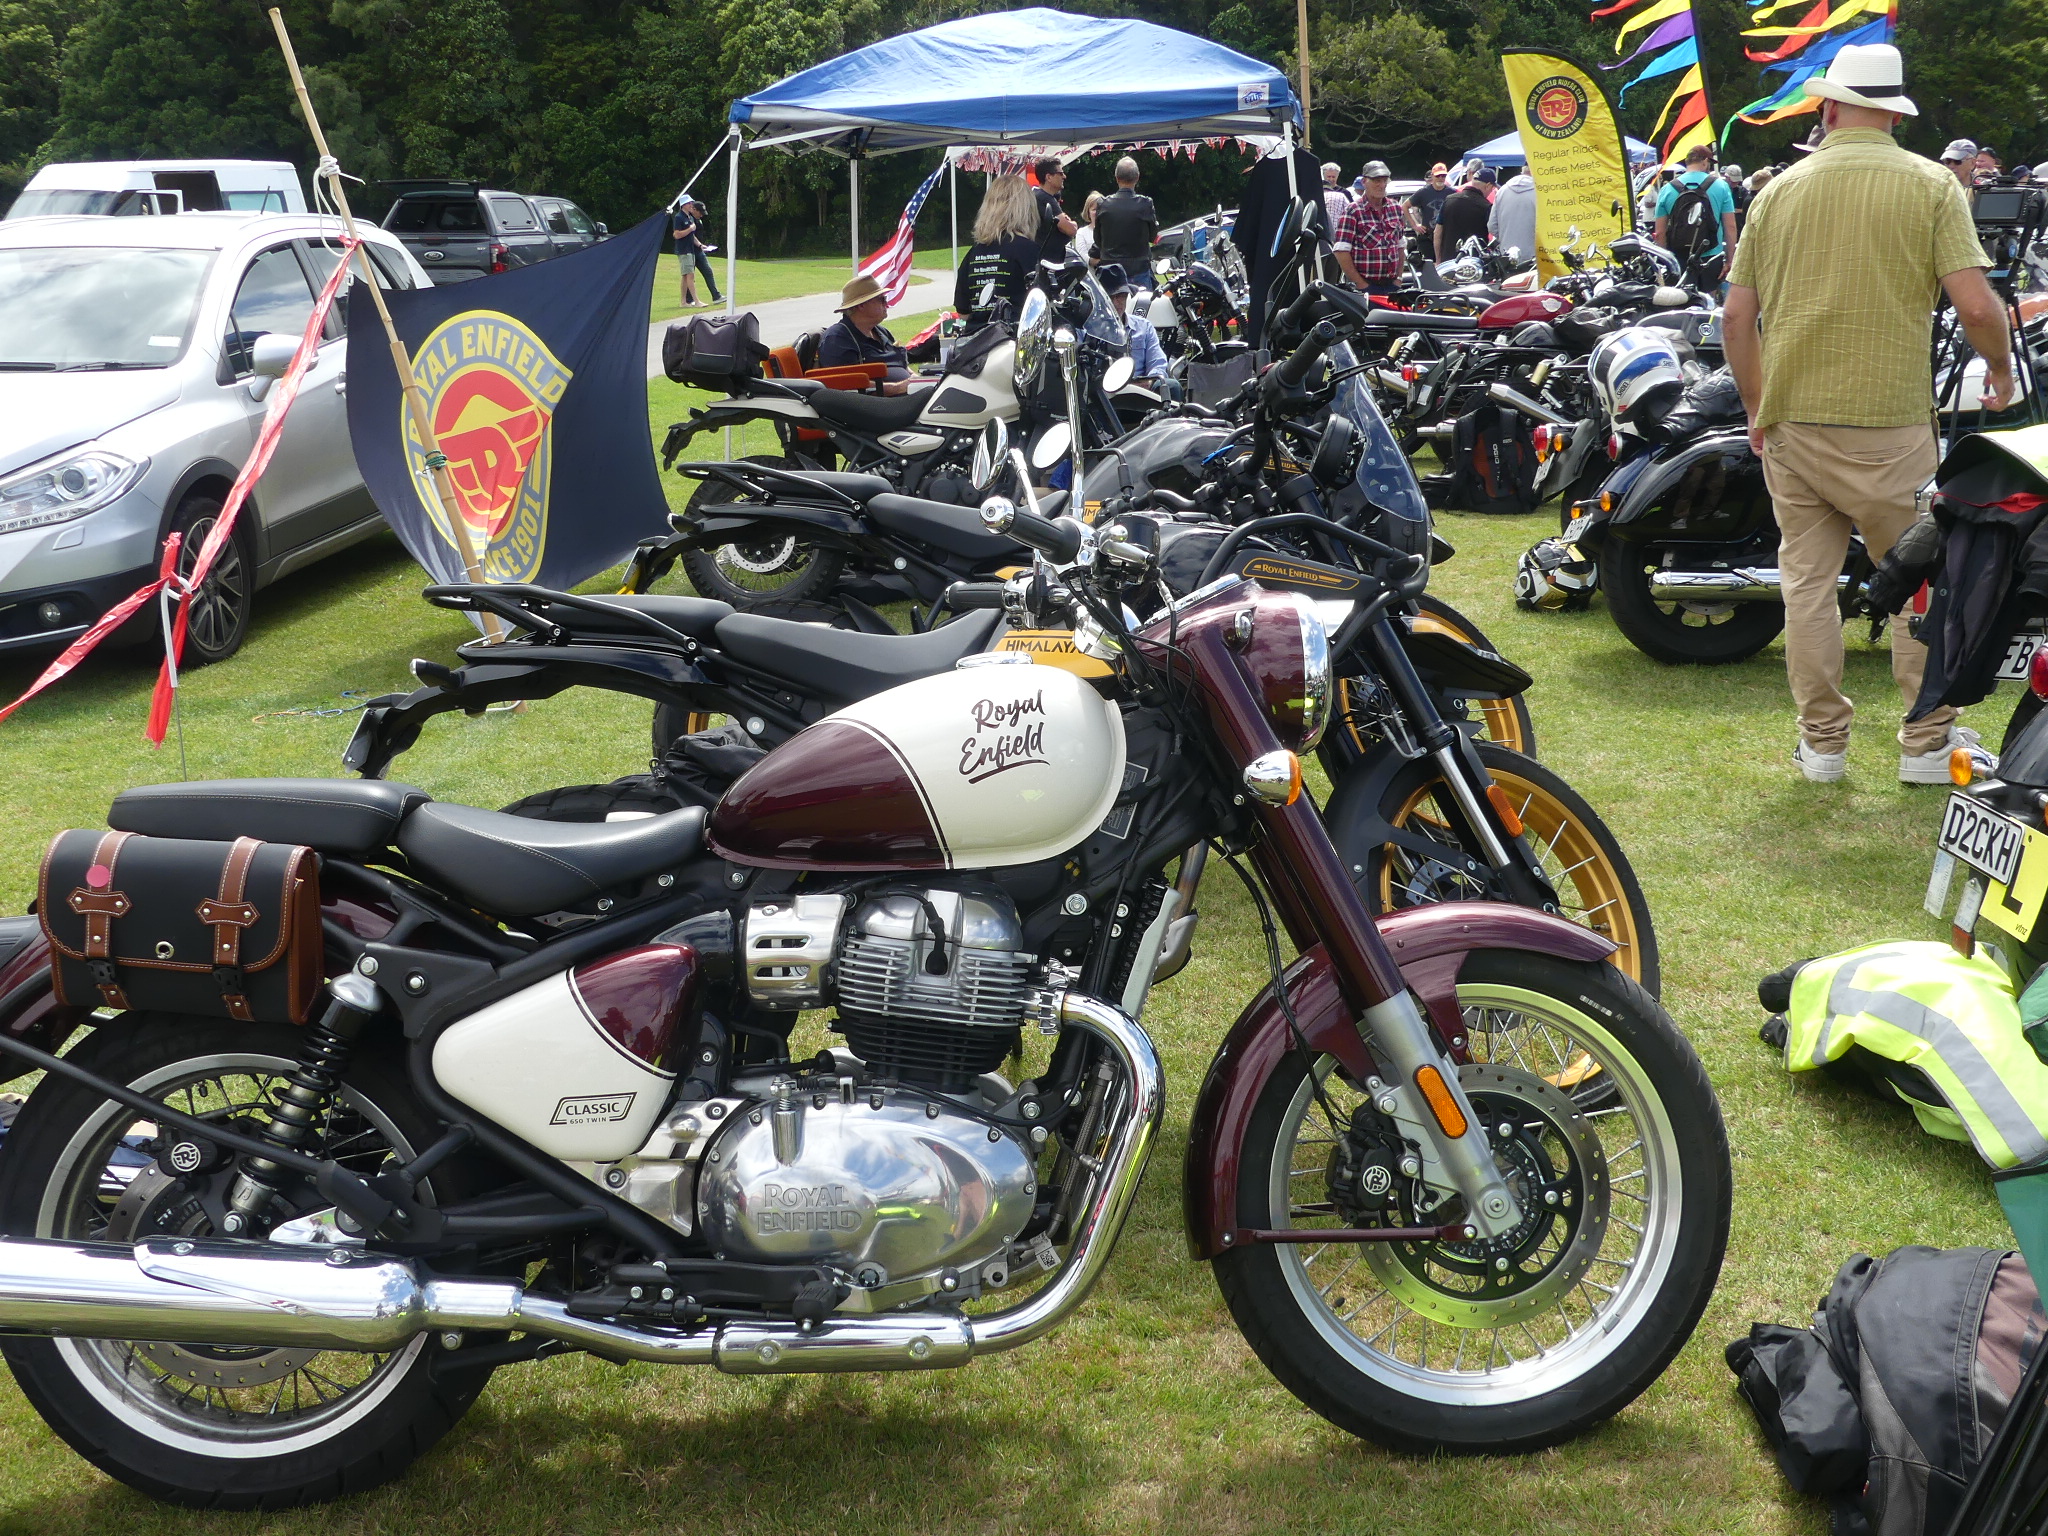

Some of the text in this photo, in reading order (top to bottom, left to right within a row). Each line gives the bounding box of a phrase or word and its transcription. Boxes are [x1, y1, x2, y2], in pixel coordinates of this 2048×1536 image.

[1535, 78, 1557, 94] ENFIELD
[1558, 78, 1578, 91] RIDERS
[1574, 88, 1586, 104] CLUB
[1535, 117, 1583, 138] of NEW ZEALAND
[1533, 144, 1600, 161] Regular Rides
[1536, 160, 1601, 176] Coffee Meets
[1572, 179, 1586, 189] RE
[1588, 175, 1613, 186] Days
[1546, 192, 1602, 207] Annual Rally
[1549, 210, 1603, 224] RE Displays
[1547, 226, 1613, 240] Histo Events
[460, 323, 569, 404] ENFIELD
[1492, 443, 1500, 464] OGIO
[485, 492, 542, 577] NCE 1901
[1262, 563, 1320, 582] ROYAL ENFIELD
[1005, 639, 1082, 654] HIMALAYA
[971, 688, 1046, 734] Royal
[959, 721, 1045, 776] Enfield
[1943, 802, 2017, 876] D2CKH
[565, 1102, 620, 1116] CLASSIC
[586, 1116, 607, 1124] TWIN
[764, 1183, 850, 1211] ROYAL
[757, 1210, 863, 1236] ENFIELD
